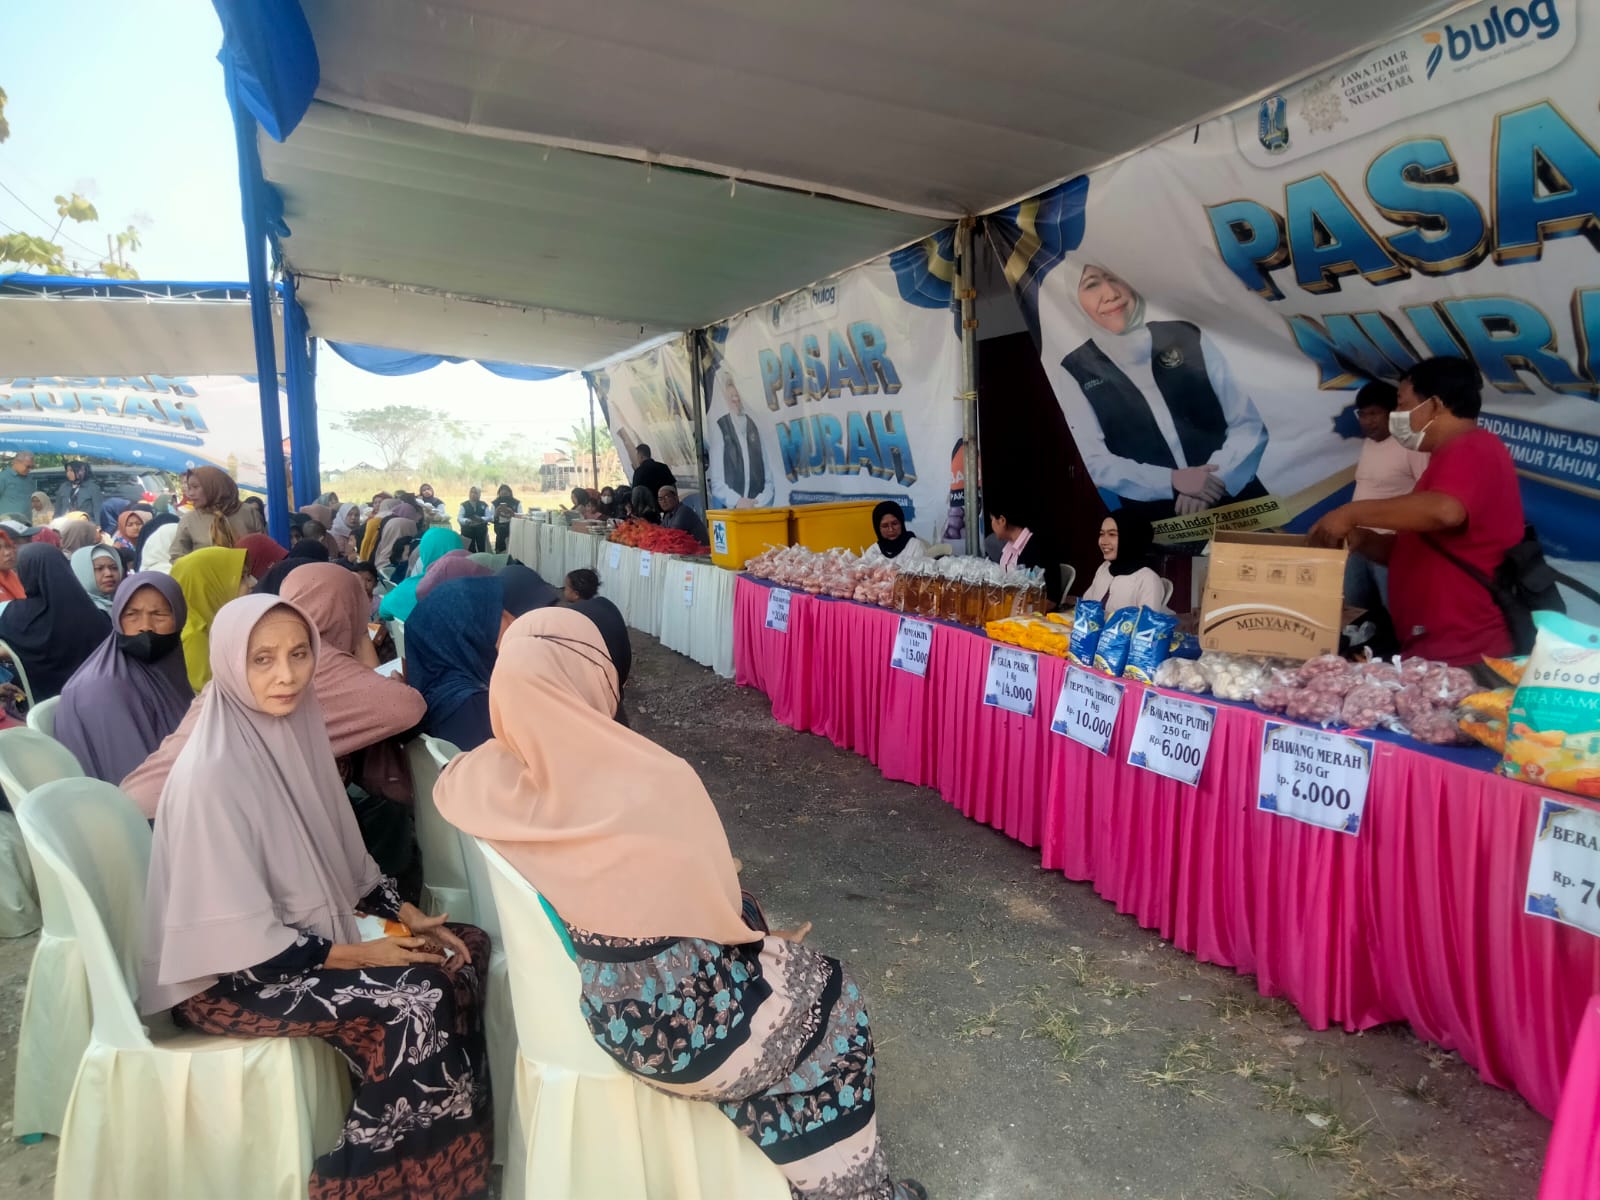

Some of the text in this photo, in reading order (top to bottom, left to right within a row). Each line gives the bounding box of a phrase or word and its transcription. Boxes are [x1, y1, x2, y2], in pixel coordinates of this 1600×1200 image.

[1444, 0, 1561, 61] bulog
[1340, 50, 1409, 88] JAWA TIMUR
[1348, 75, 1415, 106] NUSANTARA
[1203, 98, 1600, 301] PASA
[760, 320, 903, 412] PASAR
[775, 411, 918, 487] MURAH
[1543, 431, 1598, 456] INFLASI
[1547, 453, 1597, 478] TAHUN
[1183, 516, 1212, 529] Indar
[1069, 681, 1094, 697] TEPUNG
[1533, 667, 1600, 685] befood
[1001, 682, 1032, 702] 14.000
[1084, 698, 1100, 713] 1 Kg
[1076, 709, 1112, 738] 10.000
[1162, 724, 1192, 740] 250 Gr
[1149, 734, 1200, 766] Rp. 6.000
[1272, 738, 1362, 770] BAWANG MERAH
[1294, 760, 1330, 779] 250 Gr
[1292, 779, 1351, 810] 6.000
[1552, 825, 1600, 852] BERA
[1553, 870, 1575, 888] Rp.
